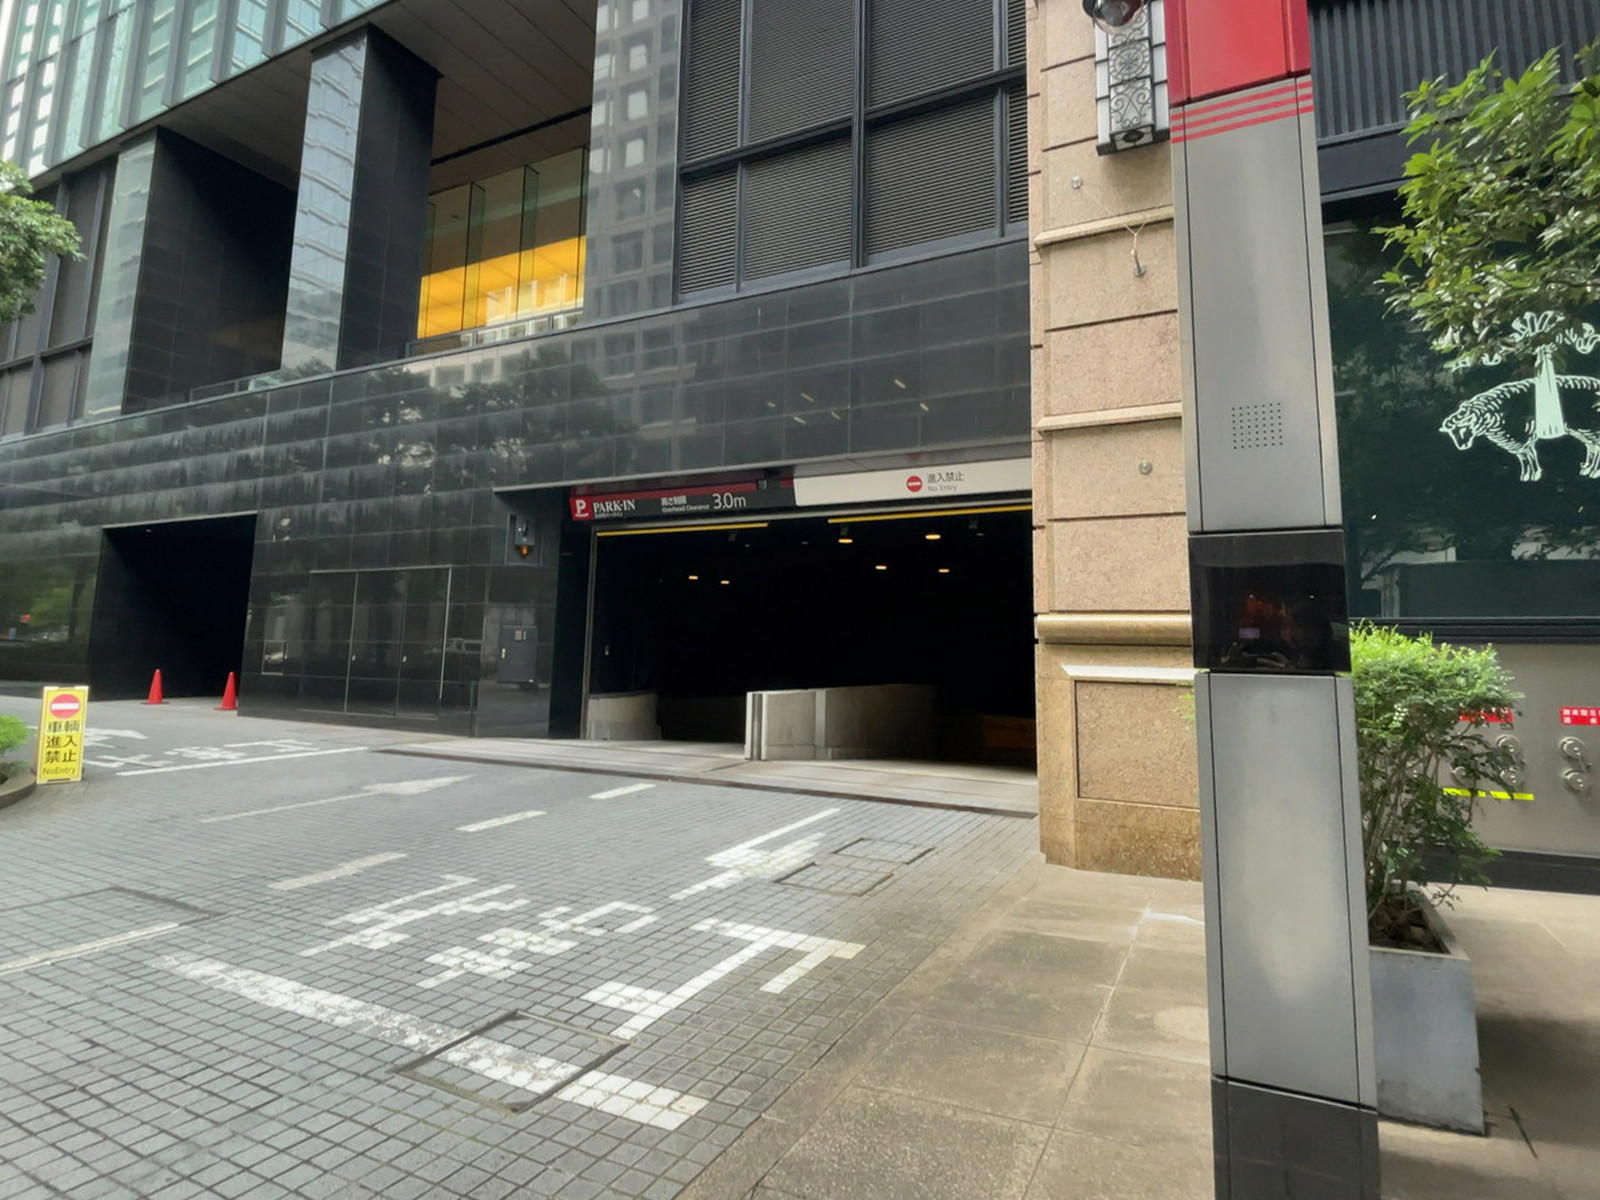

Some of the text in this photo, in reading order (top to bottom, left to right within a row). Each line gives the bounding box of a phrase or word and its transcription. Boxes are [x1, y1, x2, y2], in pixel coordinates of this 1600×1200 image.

[928, 471, 965, 484] 進入禁止
[939, 484, 957, 492] Entry
[592, 499, 636, 513] PARK-IN
[712, 492, 747, 510] 3.0m
[46, 734, 77, 749] 進入
[45, 749, 77, 764] 禁止
